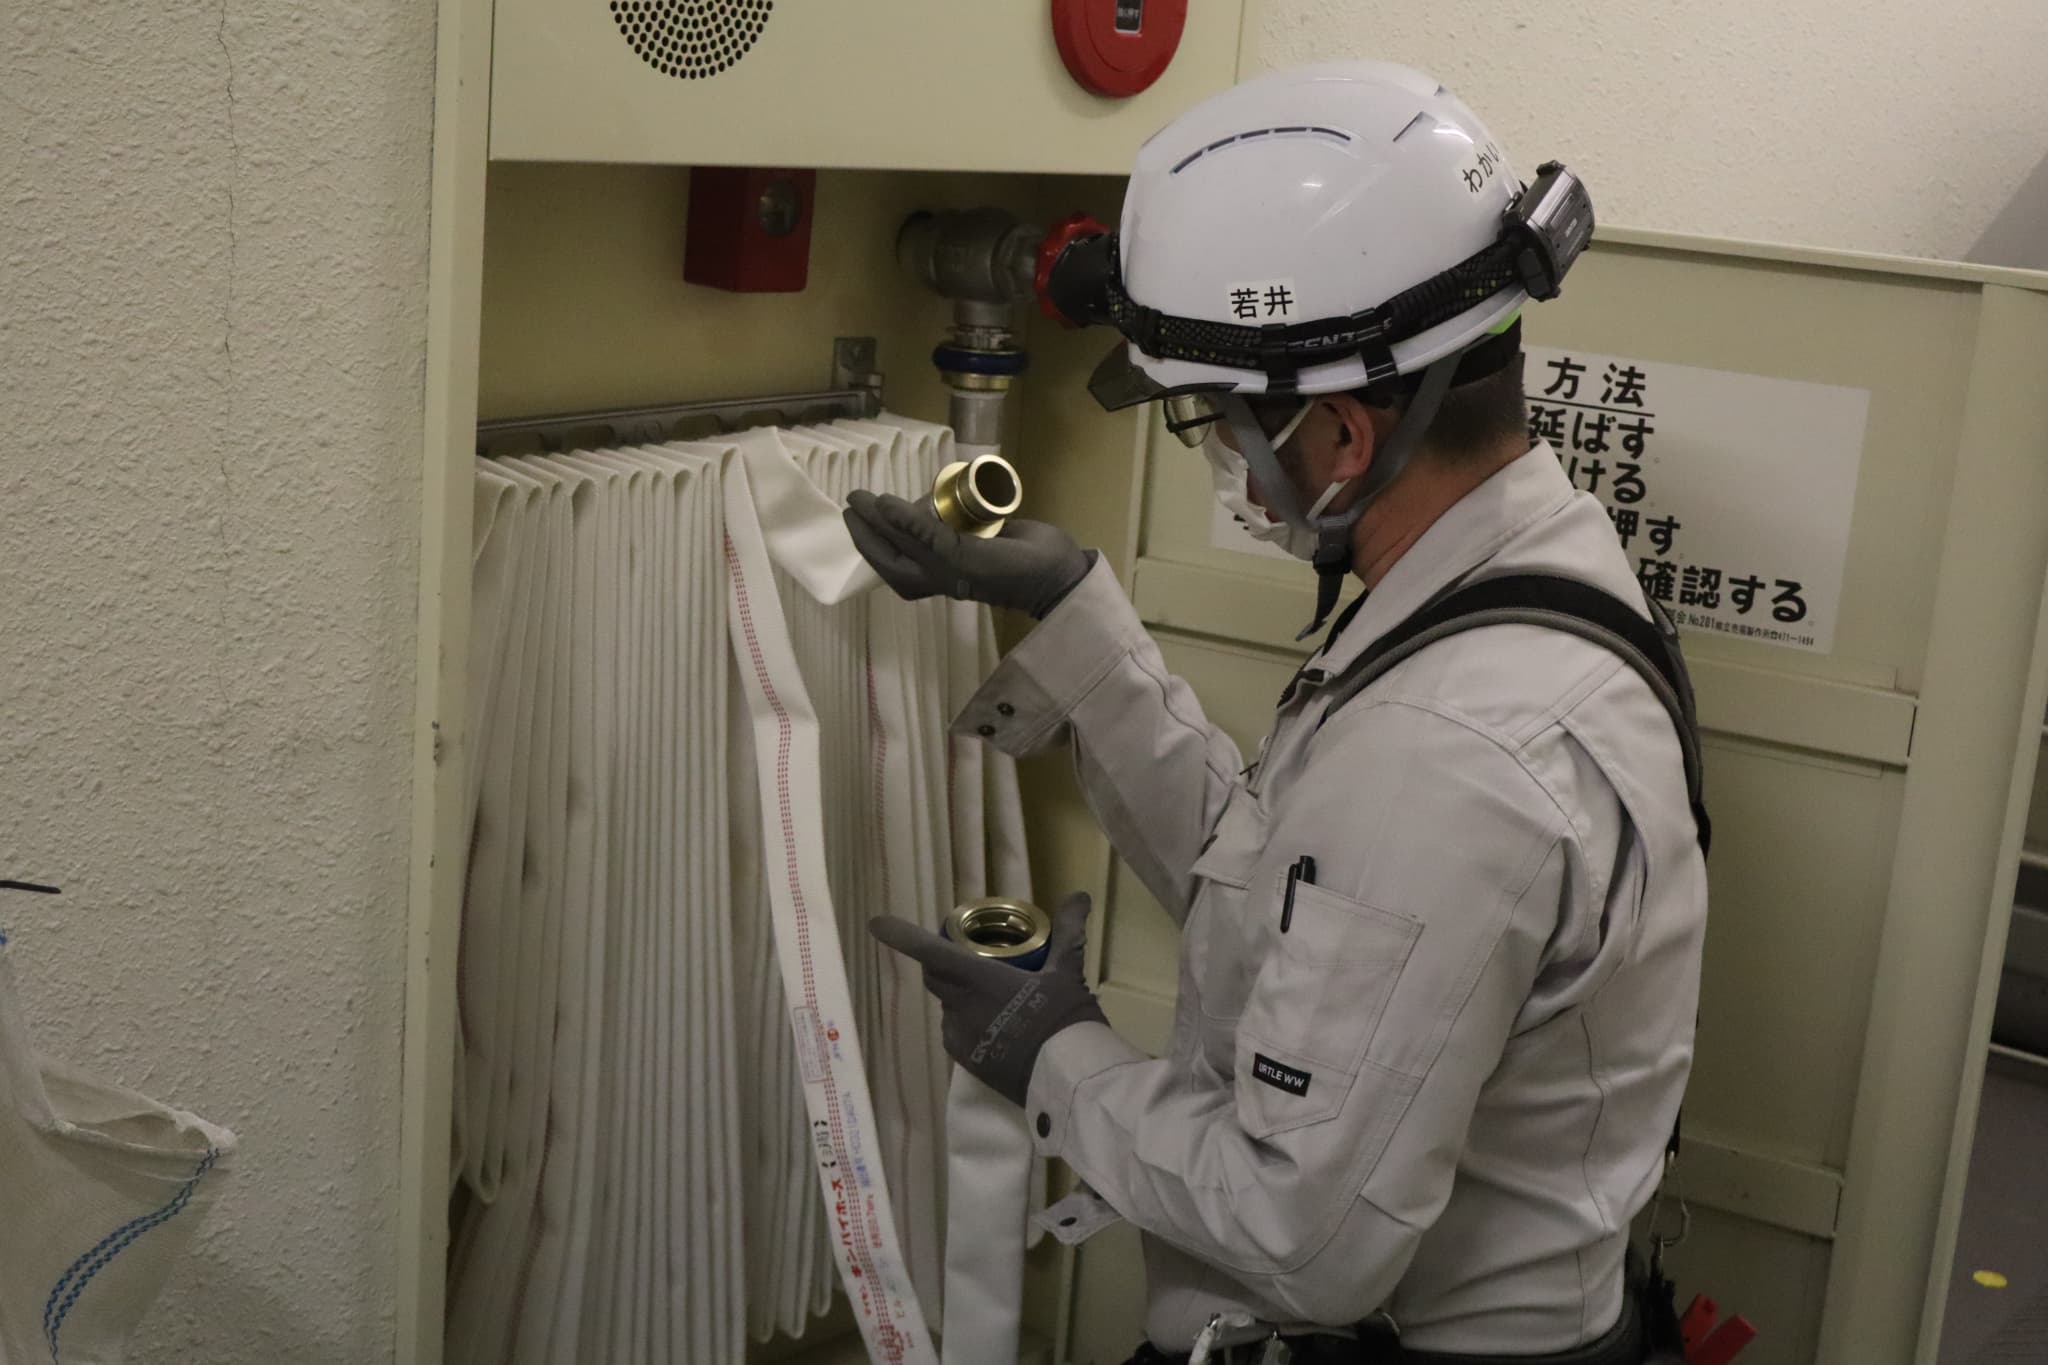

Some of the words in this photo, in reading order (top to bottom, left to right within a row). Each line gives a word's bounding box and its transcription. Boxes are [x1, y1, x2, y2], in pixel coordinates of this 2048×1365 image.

[1461, 141, 1500, 193] わかい
[1230, 285, 1294, 319] 若井
[1544, 357, 1646, 408] 方法
[1527, 405, 1654, 460] 延ばす
[1555, 454, 1647, 504] ける
[1636, 556, 1808, 624] 確認する
